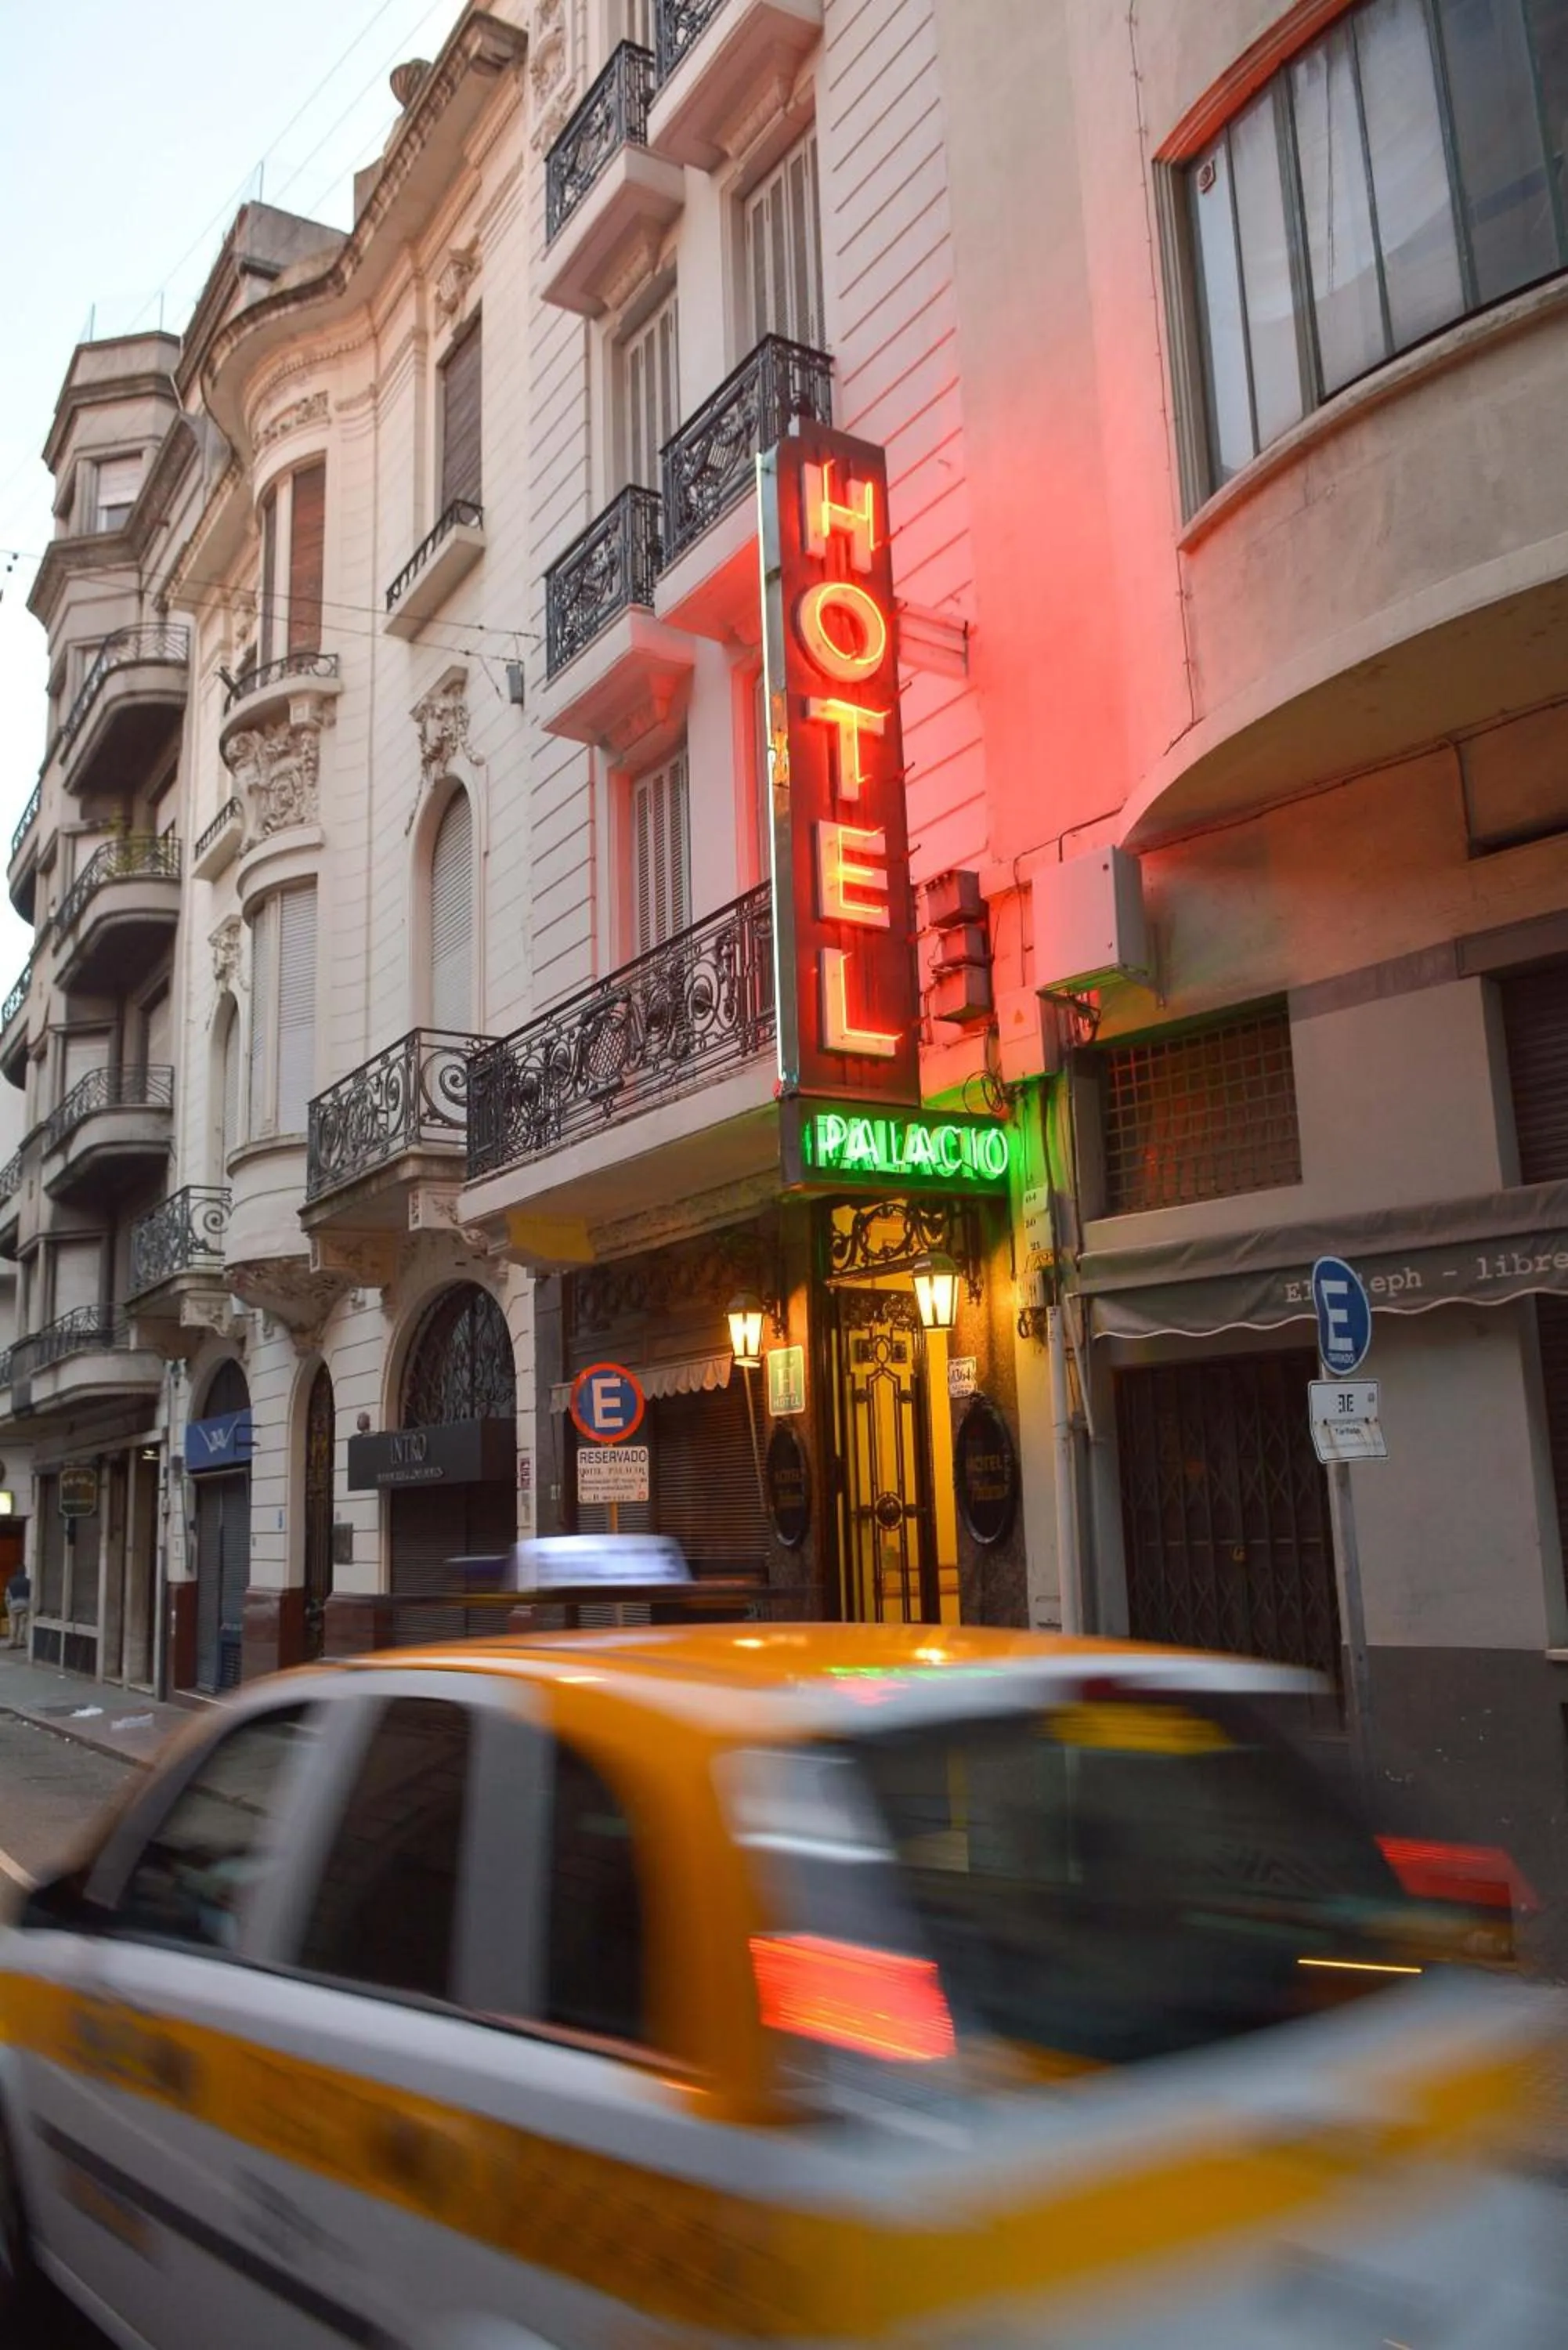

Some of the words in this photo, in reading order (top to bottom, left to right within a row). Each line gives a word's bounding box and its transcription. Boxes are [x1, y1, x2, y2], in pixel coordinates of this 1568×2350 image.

[797, 459, 902, 1058] HOTEL
[811, 1113, 1012, 1177] PALACIO
[1357, 1266, 1422, 1297] eph
[1321, 1280, 1353, 1351] E
[591, 1377, 624, 1429] E
[773, 1395, 801, 1409] HOTEL
[579, 1450, 647, 1464] RESERVADO
